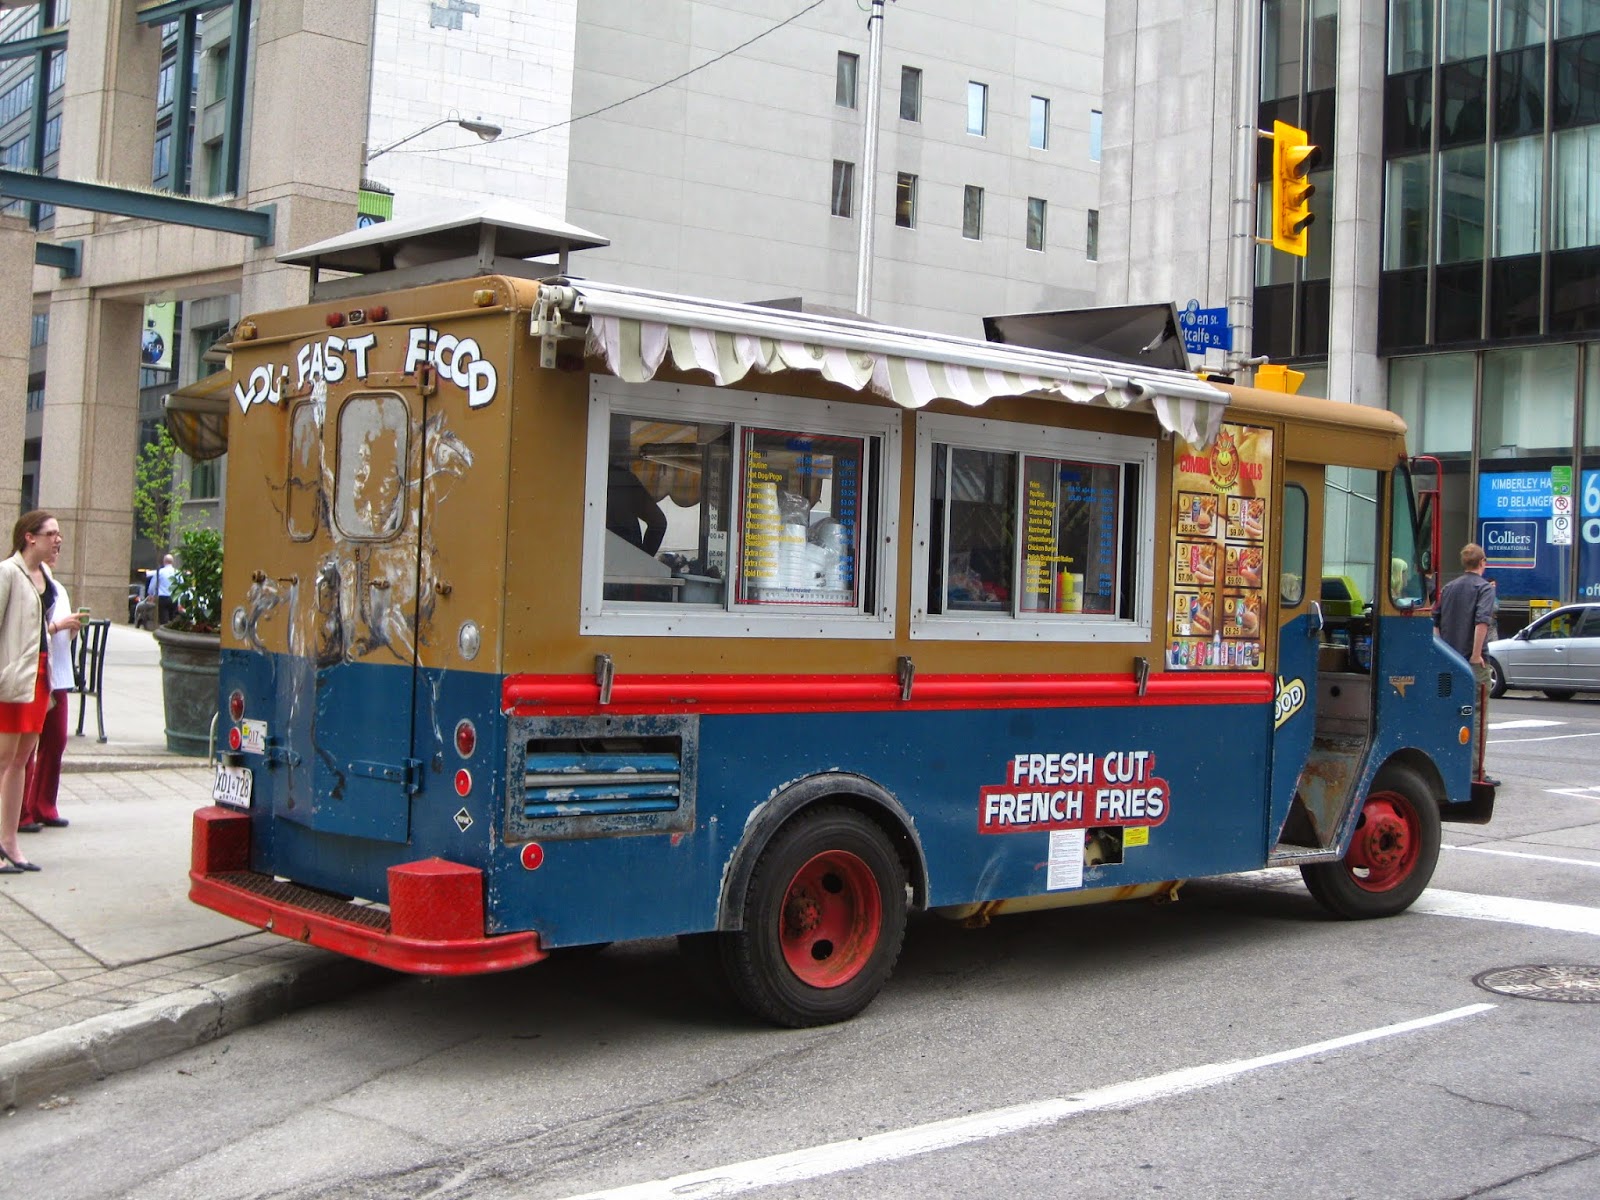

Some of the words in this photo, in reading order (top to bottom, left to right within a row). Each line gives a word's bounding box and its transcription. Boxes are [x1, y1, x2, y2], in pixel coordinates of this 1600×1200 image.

[1182, 327, 1210, 344] tcalfe
[297, 333, 377, 391] FAST
[404, 326, 498, 408] FOOD
[1492, 478, 1538, 490] KIMBERLEY
[1497, 496, 1509, 508] ED
[1488, 530, 1531, 544] Colliers
[1013, 752, 1095, 786] FRESH
[1103, 751, 1150, 784] CUT
[984, 790, 1084, 826] FRENCH
[1095, 786, 1165, 820] FRIES
